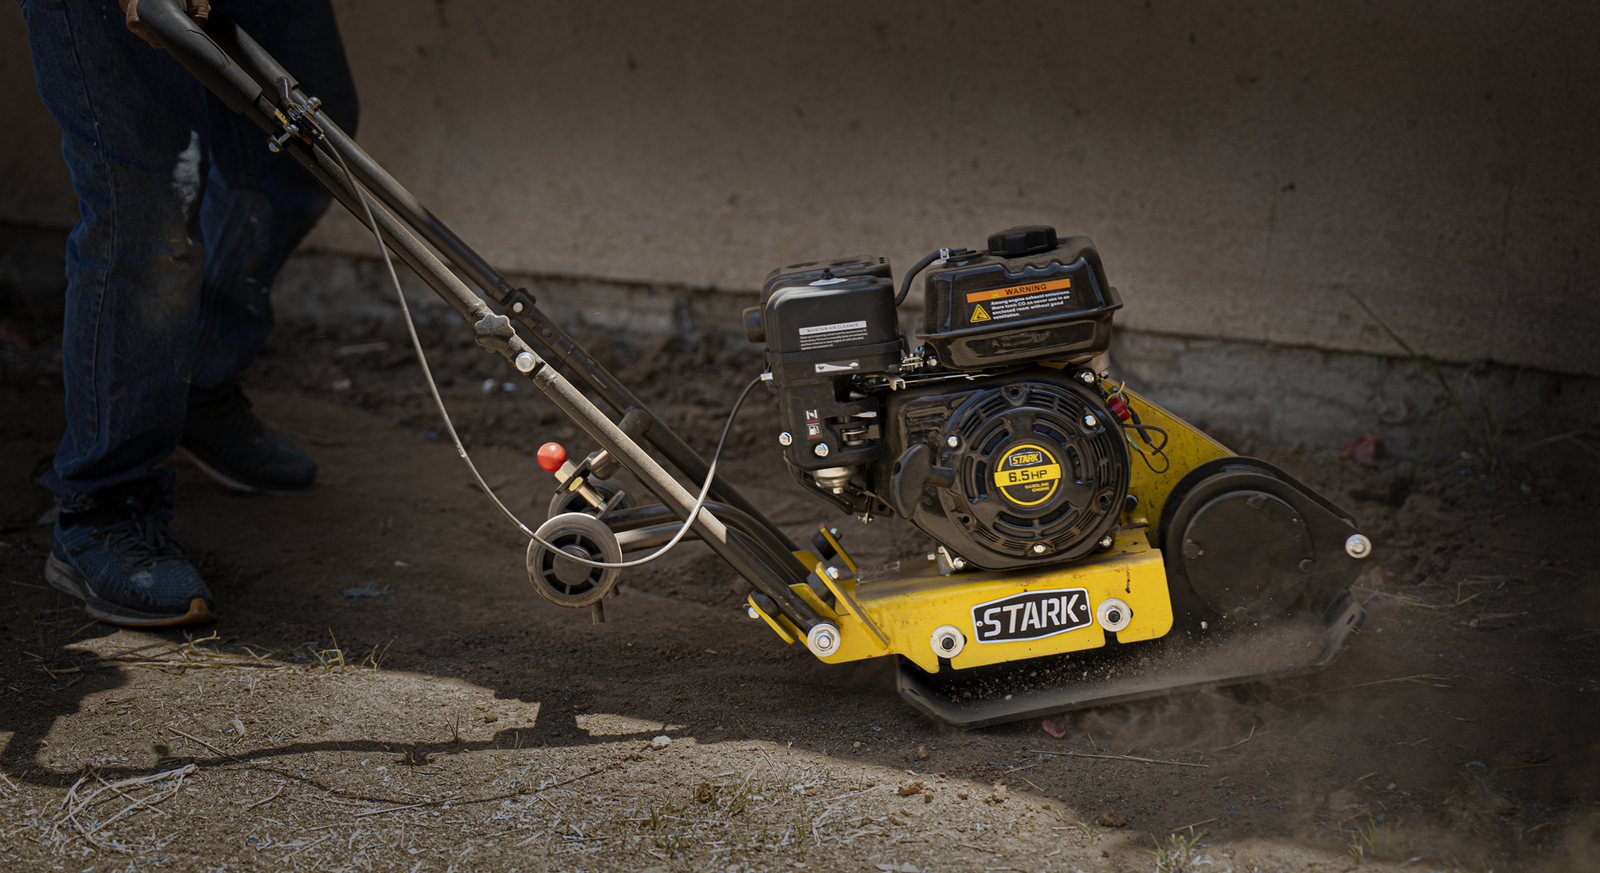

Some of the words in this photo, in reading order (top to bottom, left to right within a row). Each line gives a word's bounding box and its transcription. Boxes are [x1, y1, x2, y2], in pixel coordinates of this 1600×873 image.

[1005, 284, 1047, 296] WARNING
[1012, 453, 1039, 465] STARK
[984, 594, 1079, 637] STARK
